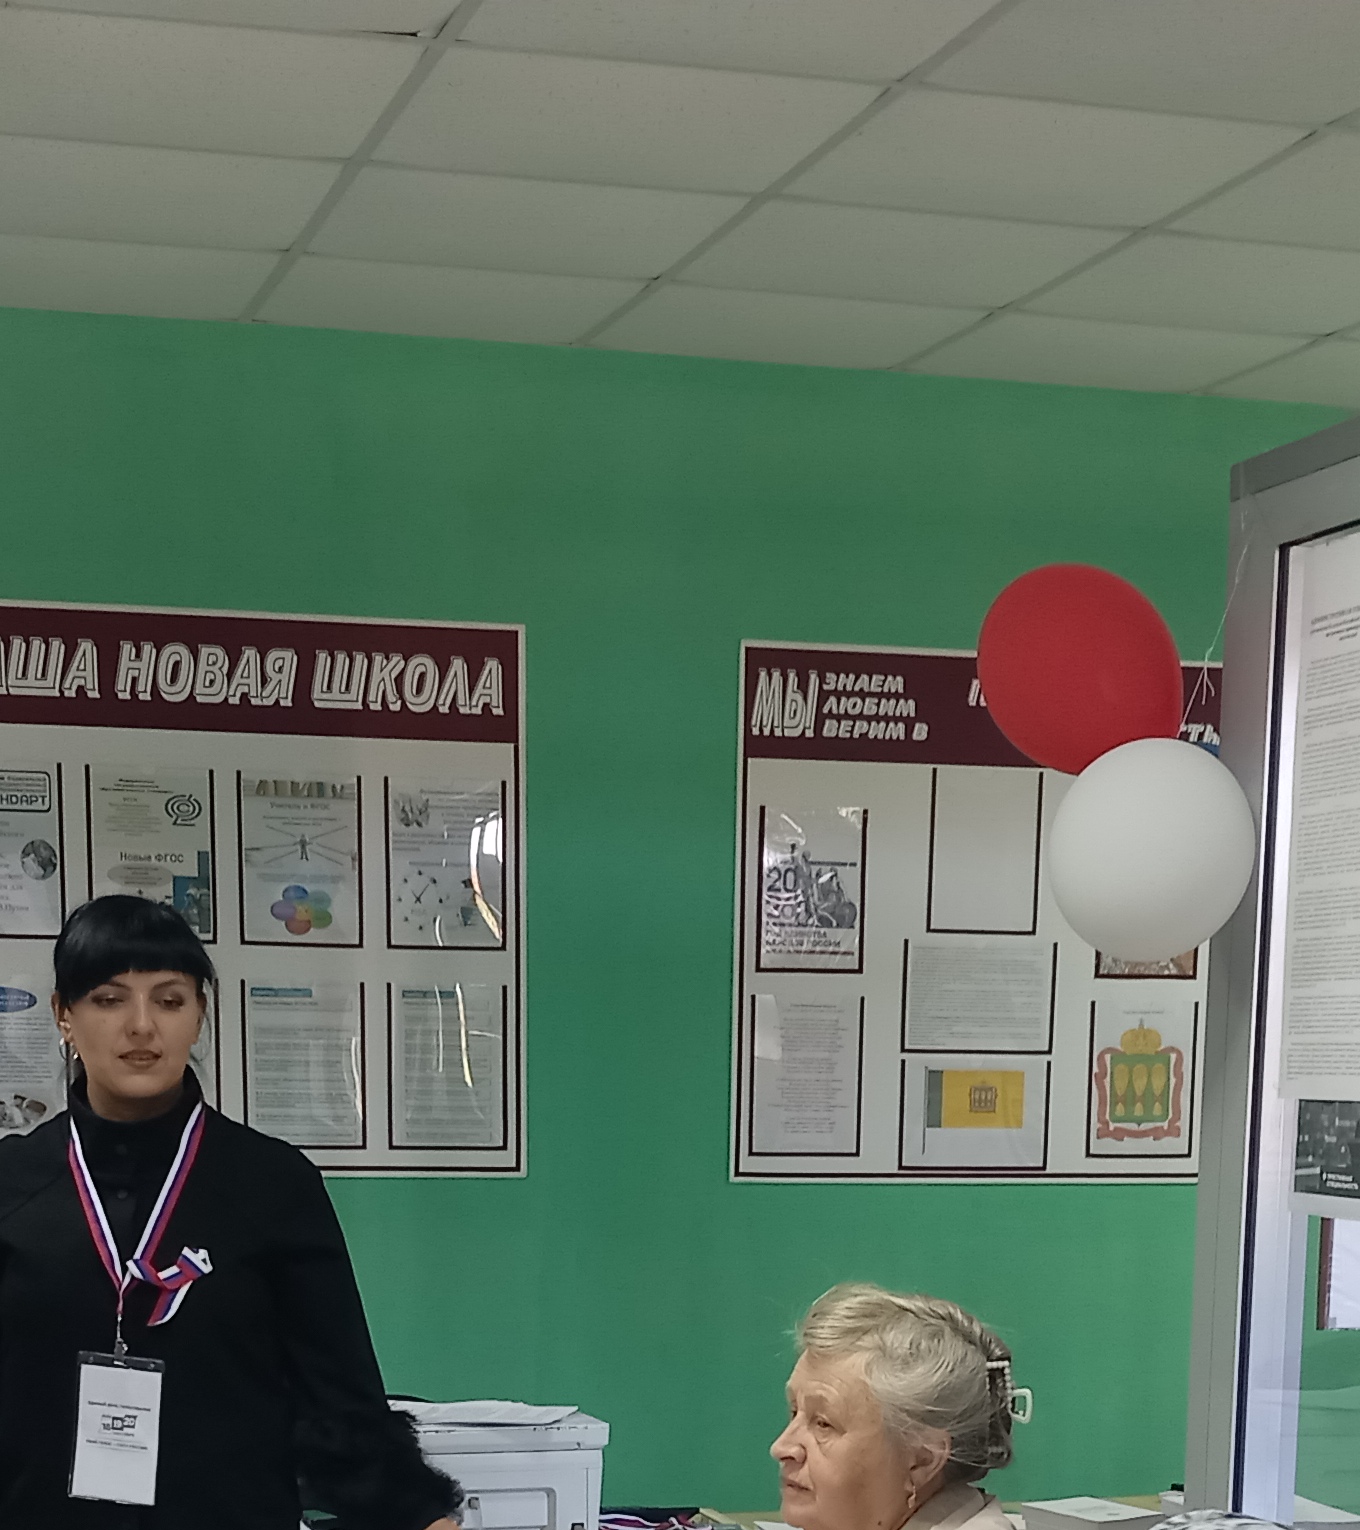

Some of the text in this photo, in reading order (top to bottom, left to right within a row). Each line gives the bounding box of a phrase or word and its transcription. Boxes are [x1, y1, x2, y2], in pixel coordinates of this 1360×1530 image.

[115, 640, 297, 707] НОВАЯ
[310, 648, 506, 716] ШКОЛА
[823, 672, 904, 693] ЗНАЕМ
[751, 668, 819, 737] МЫ
[822, 695, 916, 717] ЛЮБИМ
[822, 719, 929, 741] ВЕРИМ В
[120, 852, 184, 863] Новые ФГОС
[767, 866, 798, 892] 20
[124, 1417, 136, 1426] 20
